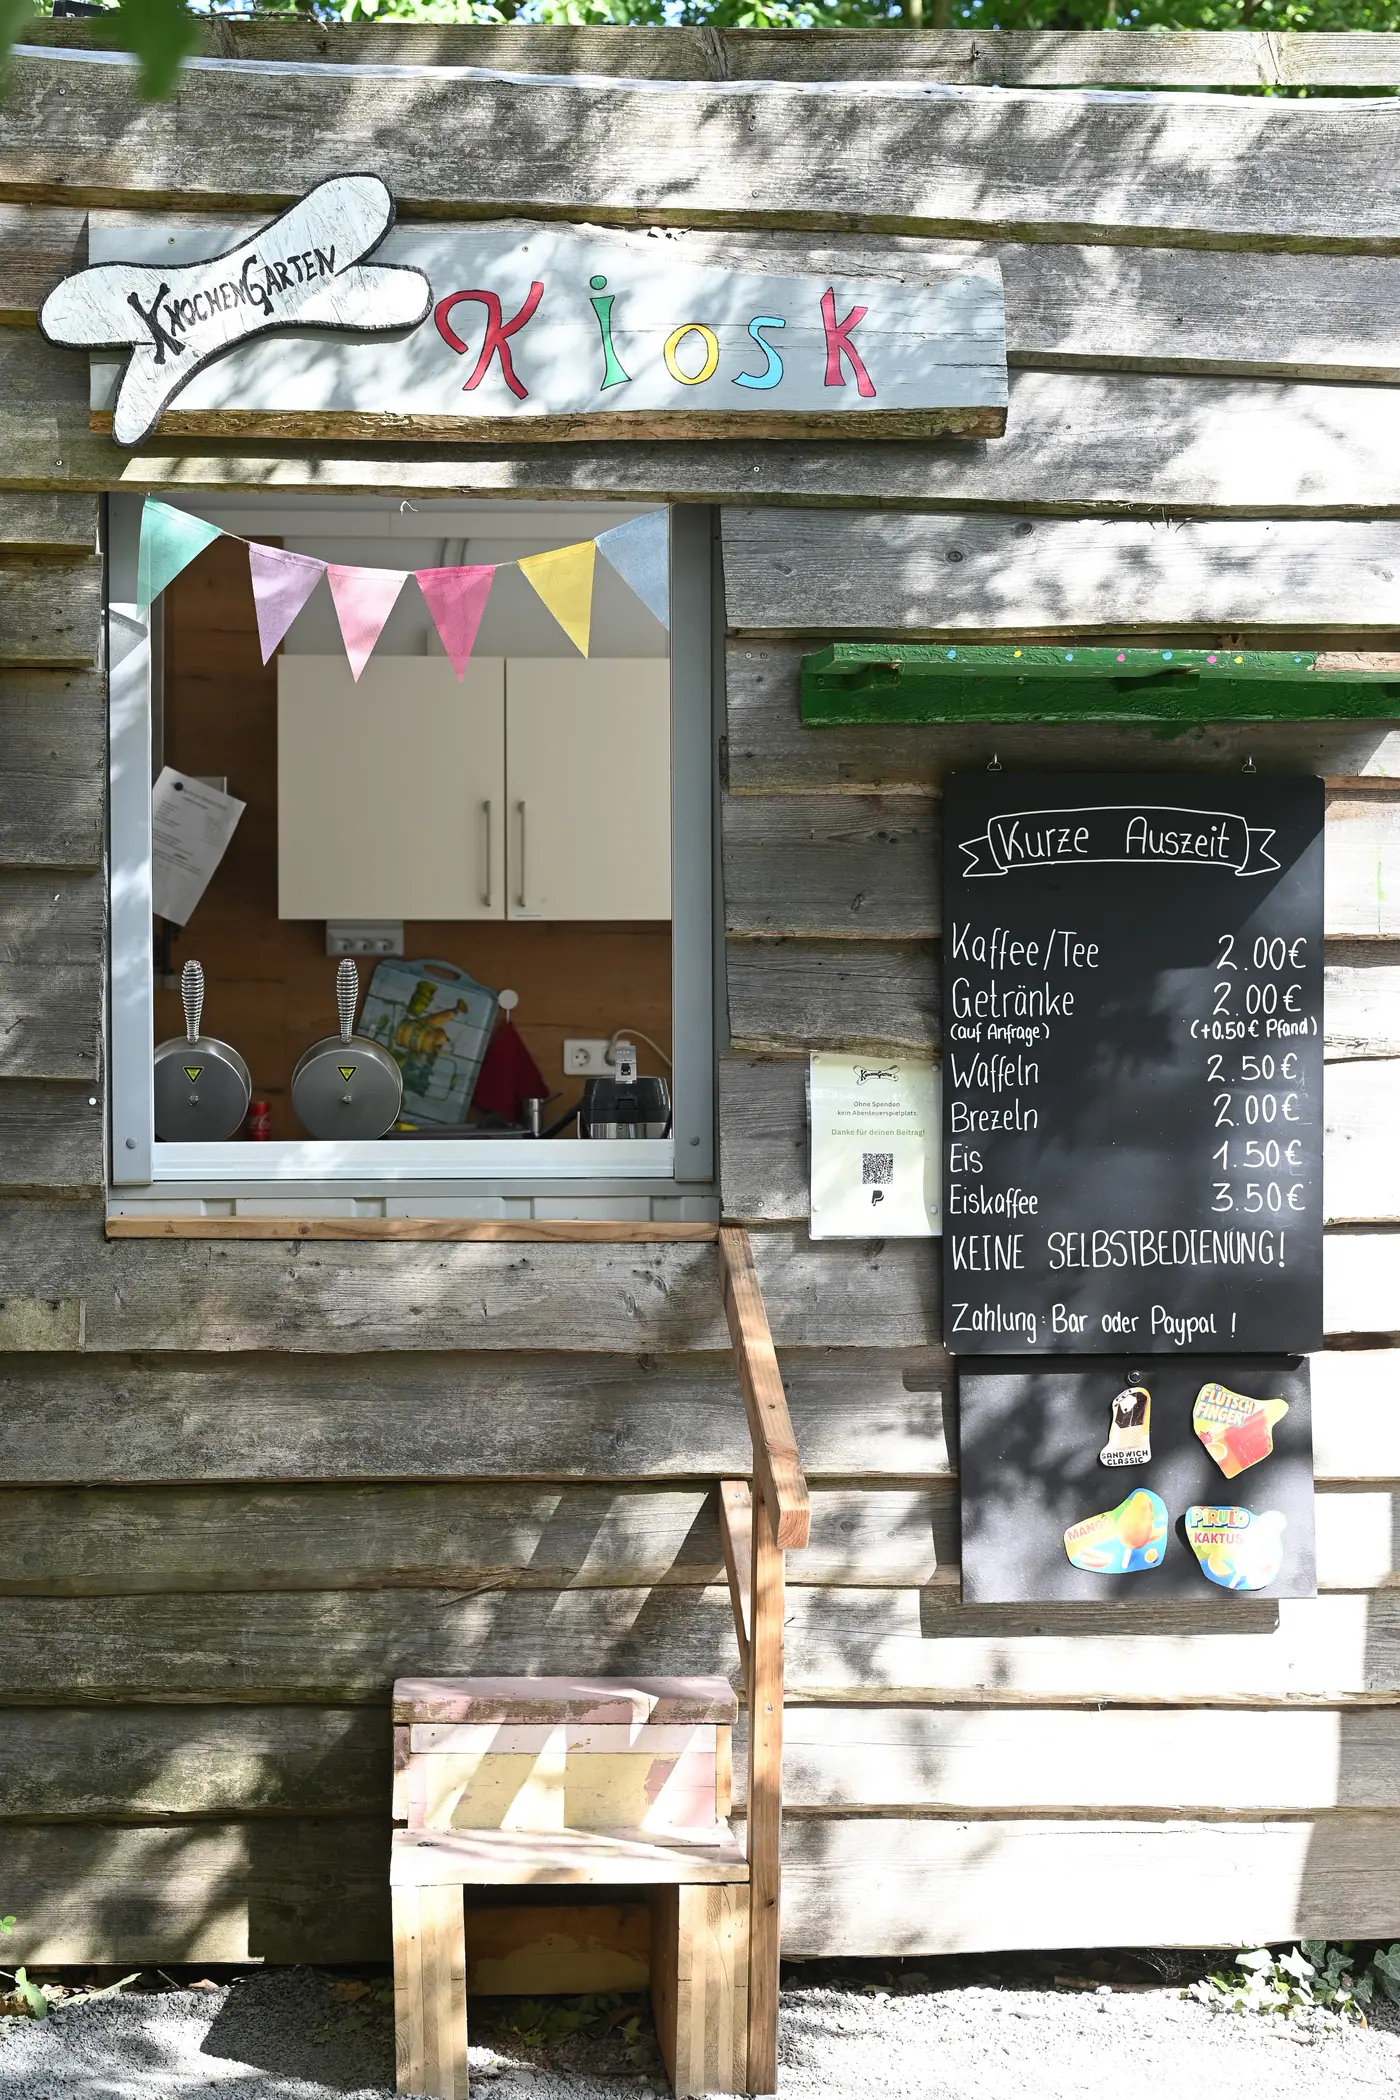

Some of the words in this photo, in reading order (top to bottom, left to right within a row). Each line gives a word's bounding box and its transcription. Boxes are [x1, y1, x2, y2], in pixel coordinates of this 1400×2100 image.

[997, 821, 1090, 861] Kurze
[1125, 816, 1231, 860] Auszeit
[952, 921, 1099, 971] Kaffee/Tee
[951, 976, 1075, 1019] Getränke
[949, 1021, 983, 1044] (auf
[1265, 1015, 1318, 1039] Pfand)
[950, 1052, 1039, 1094] Waffeln
[951, 1097, 1038, 1133] Brezeln
[896, 1129, 925, 1137] Beitrag!
[949, 1142, 984, 1174] Eis
[949, 1183, 1039, 1220] Eiskaffee
[951, 1233, 1026, 1272] KEINE
[1047, 1229, 1285, 1270] SELBSTBEDIENUNG!
[1051, 1303, 1089, 1334] Bar
[1101, 1310, 1140, 1334] oder
[1150, 1304, 1218, 1347] Paypal
[1195, 1403, 1245, 1427] FINGER
[1200, 1387, 1256, 1415] FLUTSCH
[1101, 1449, 1149, 1460] SANDWICH
[1106, 1456, 1145, 1466] CLASSIC
[1067, 1515, 1113, 1541] MANGO
